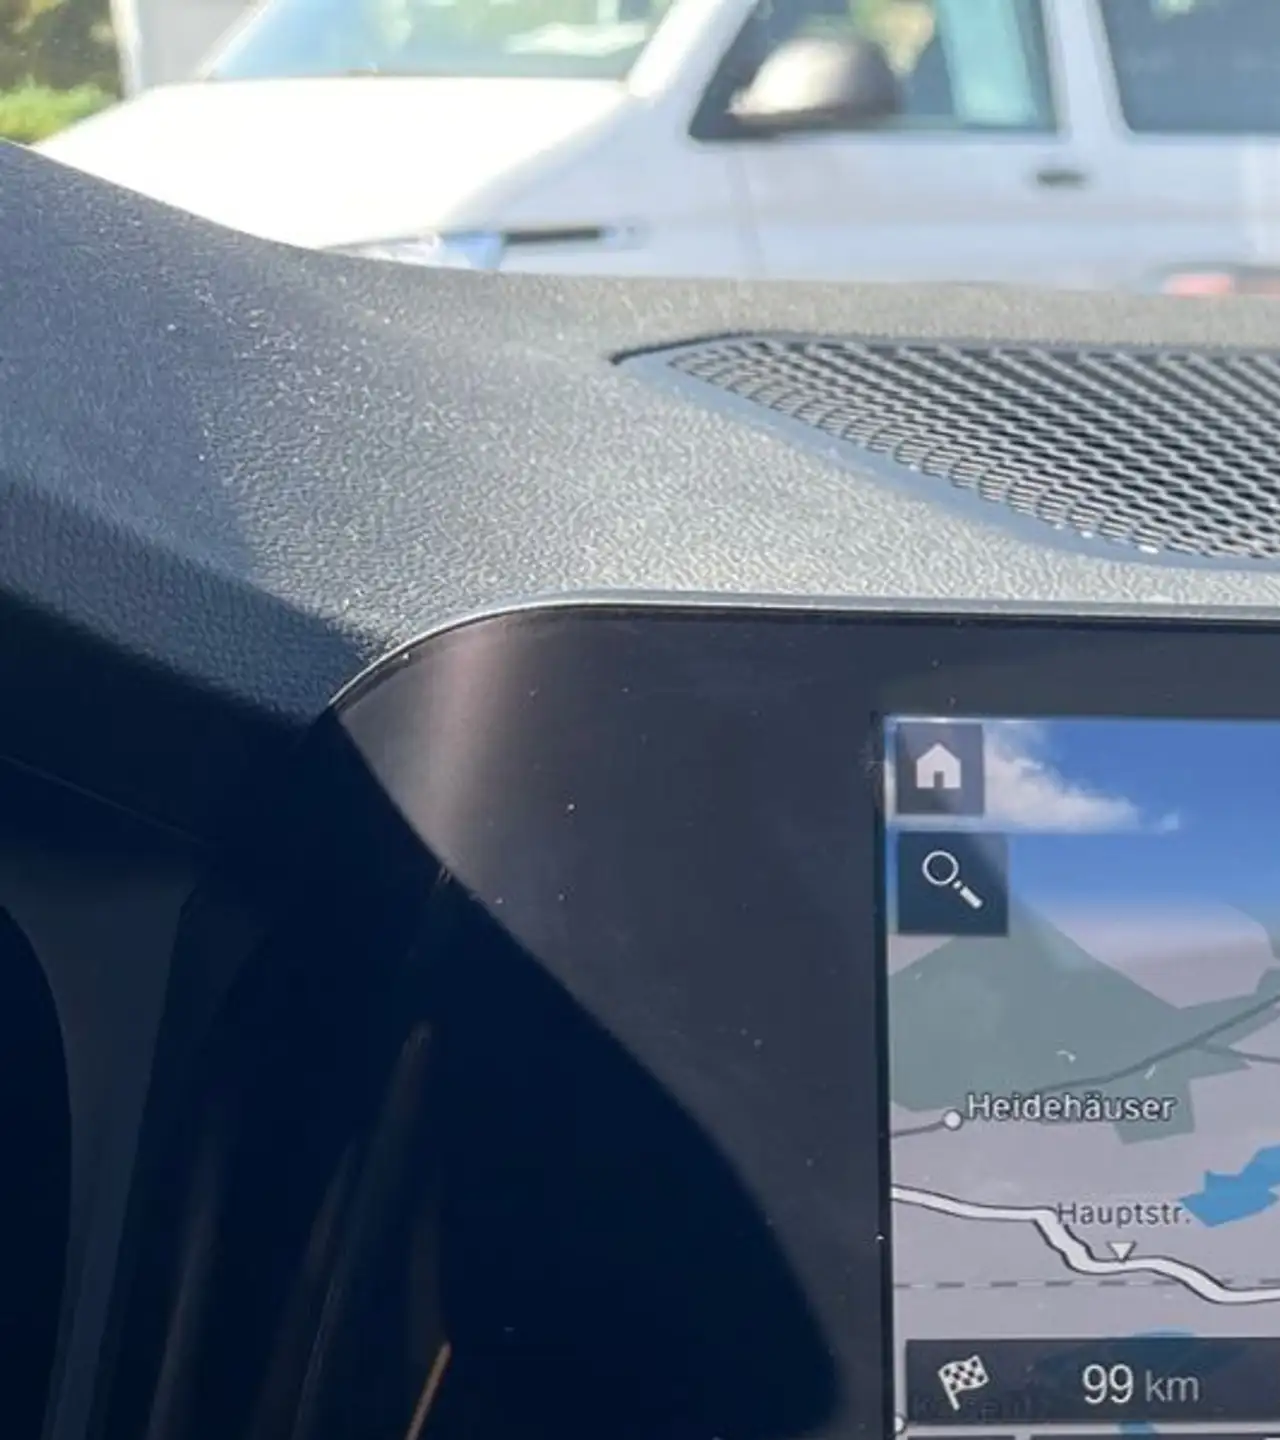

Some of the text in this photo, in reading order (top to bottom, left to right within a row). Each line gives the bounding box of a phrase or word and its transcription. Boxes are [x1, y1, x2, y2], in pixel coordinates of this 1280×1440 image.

[967, 1093, 1177, 1122] Heidehäuser
[1056, 1202, 1192, 1227] Hauptstr.
[1082, 1363, 1199, 1405] 99 km
